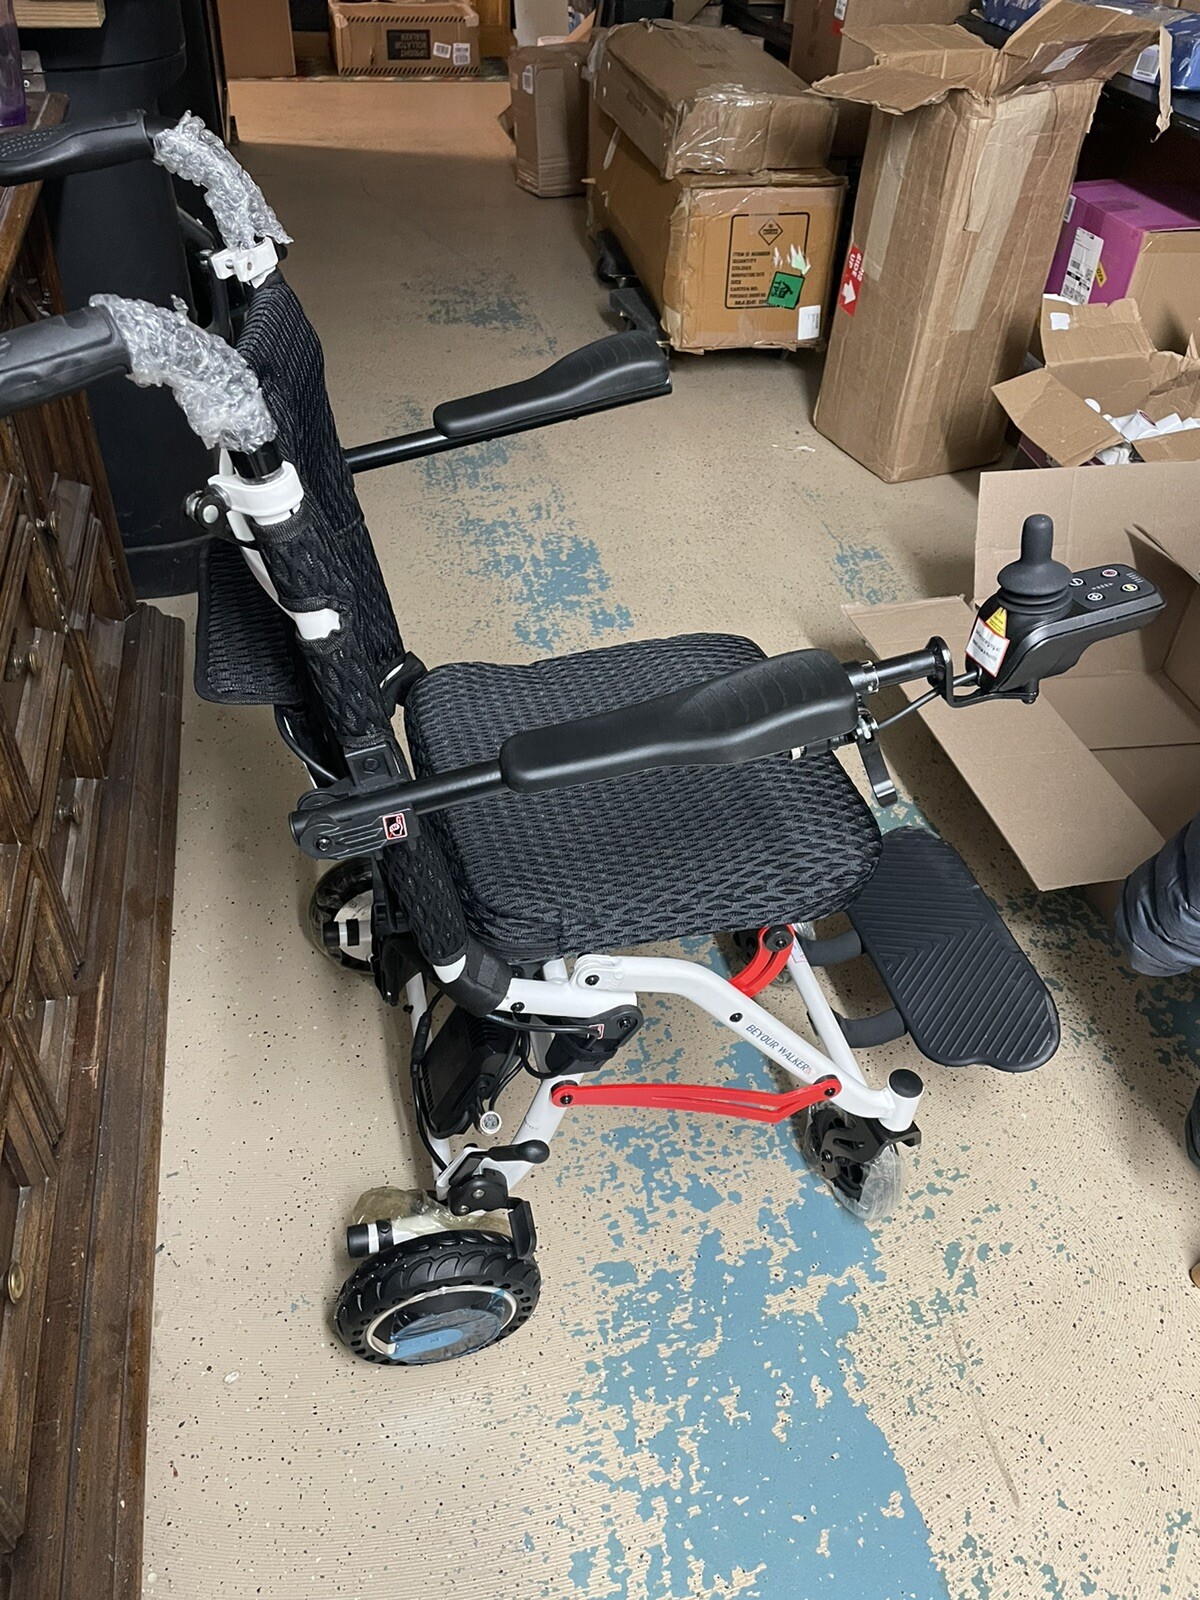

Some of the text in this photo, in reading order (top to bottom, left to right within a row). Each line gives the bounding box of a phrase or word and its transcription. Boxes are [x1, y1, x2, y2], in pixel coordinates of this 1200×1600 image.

[849, 253, 856, 269] UP
[852, 252, 862, 278] SIDE
[746, 1024, 809, 1071] BEYOUR WALKER
